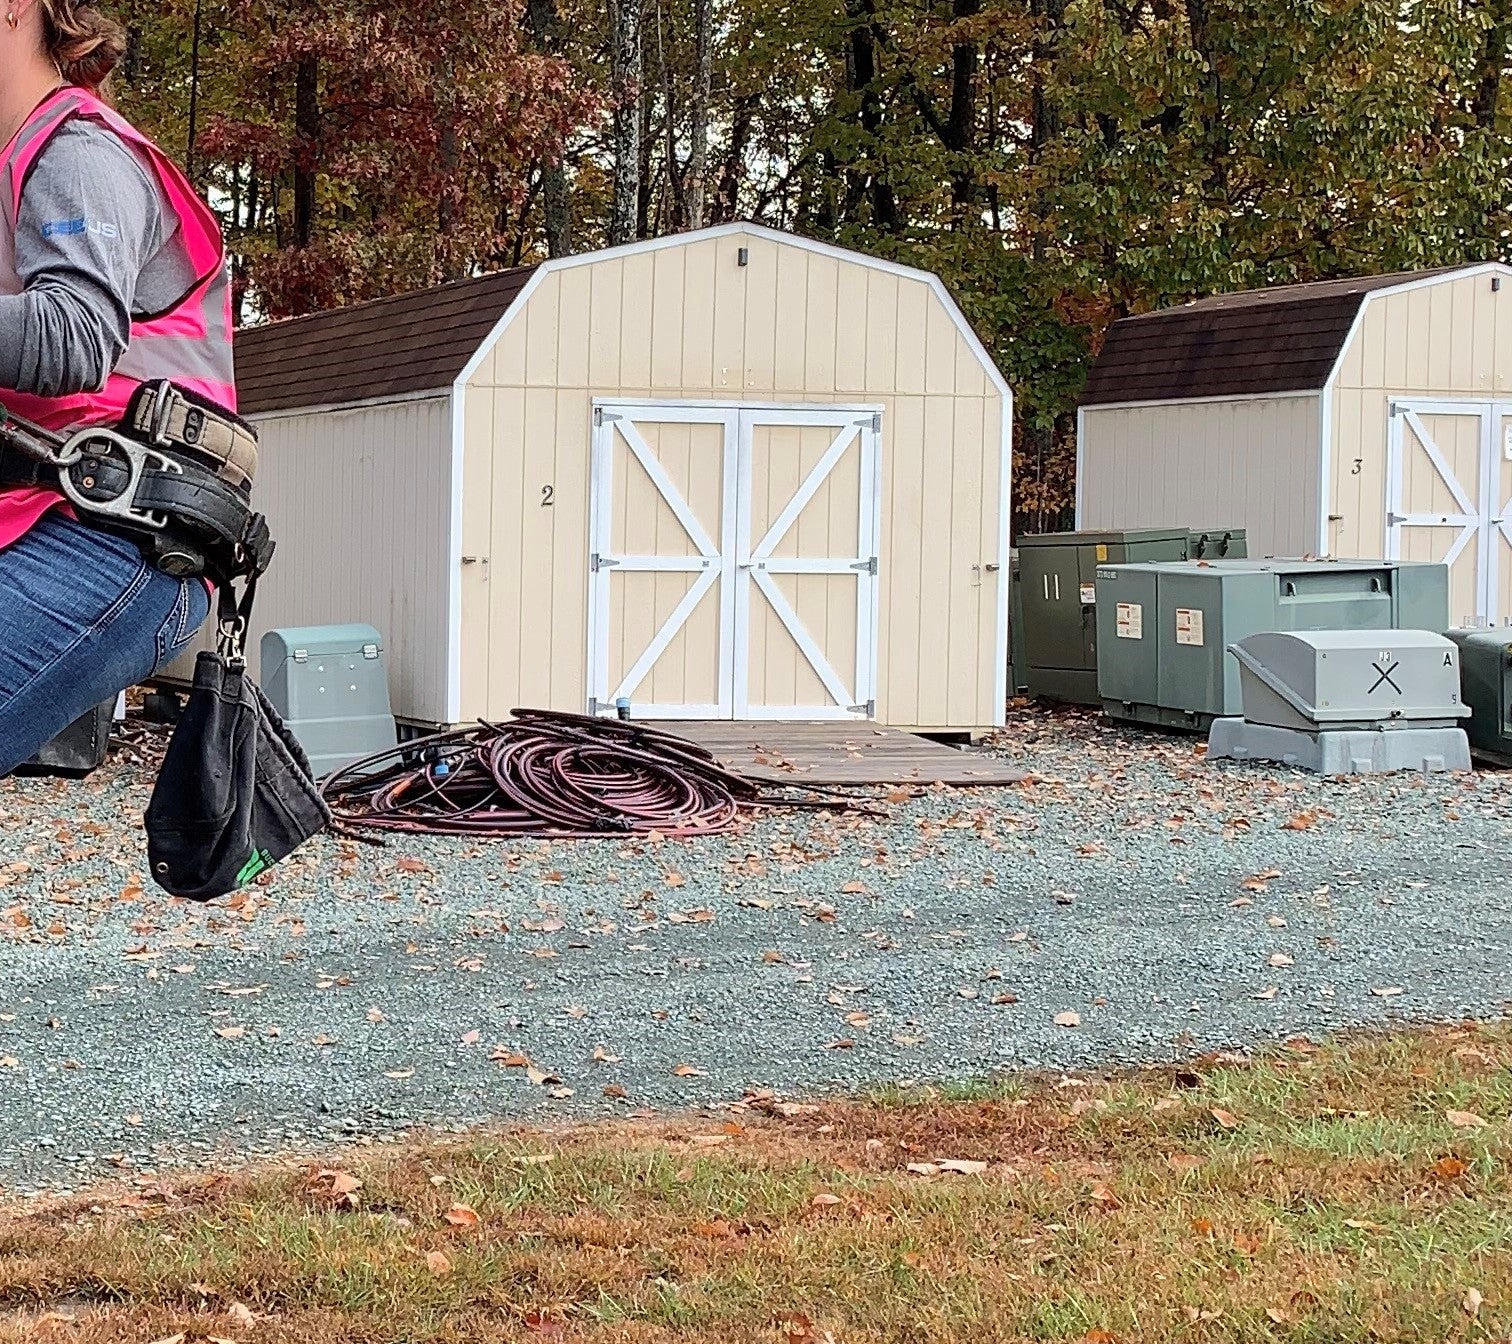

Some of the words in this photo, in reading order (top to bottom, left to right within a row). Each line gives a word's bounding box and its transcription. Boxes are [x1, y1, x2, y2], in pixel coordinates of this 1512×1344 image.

[1351, 458, 1363, 475] 3
[541, 485, 554, 507] 2
[1442, 652, 1454, 667] A
